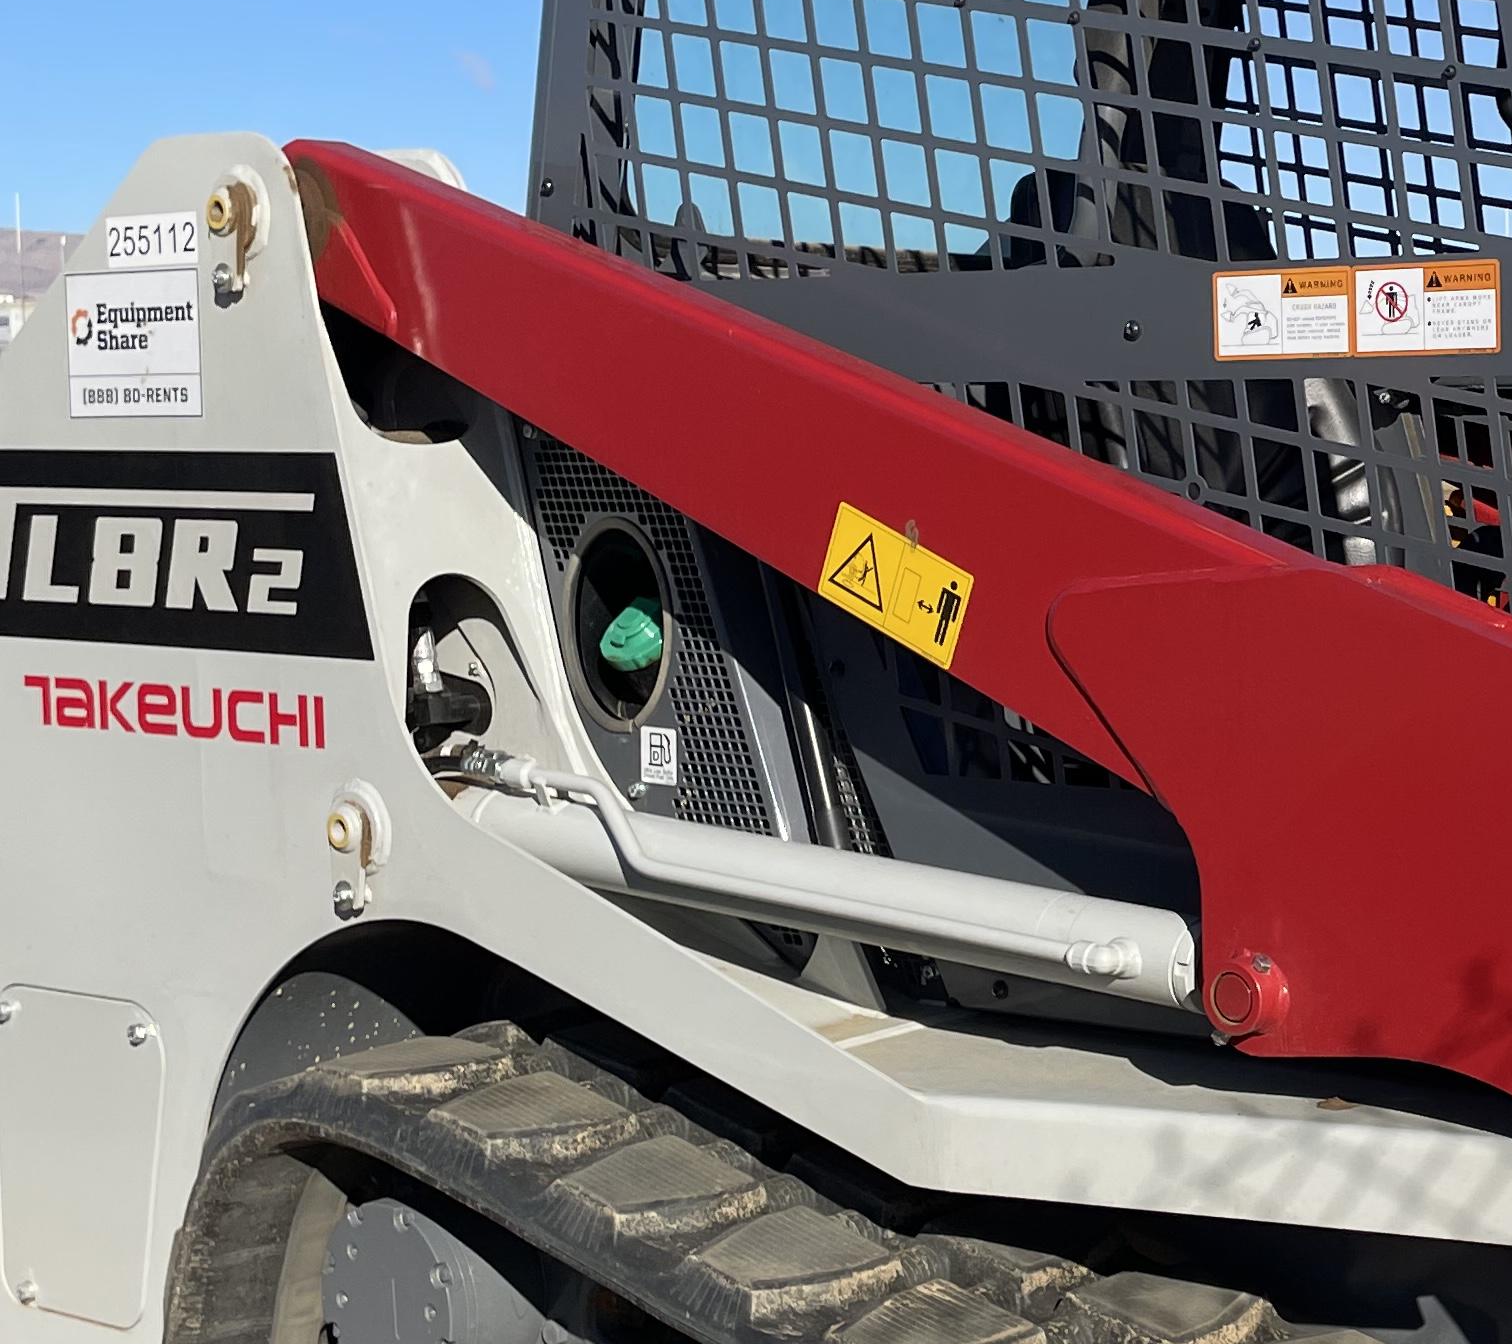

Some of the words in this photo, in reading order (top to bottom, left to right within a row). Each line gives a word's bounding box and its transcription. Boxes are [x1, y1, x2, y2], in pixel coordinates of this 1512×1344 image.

[108, 221, 196, 257] 255112
[1299, 279, 1343, 289] WARNING
[1444, 272, 1491, 283] WARNING
[96, 300, 194, 329] Equipment
[97, 329, 150, 350] Share
[82, 387, 119, 405] (888)
